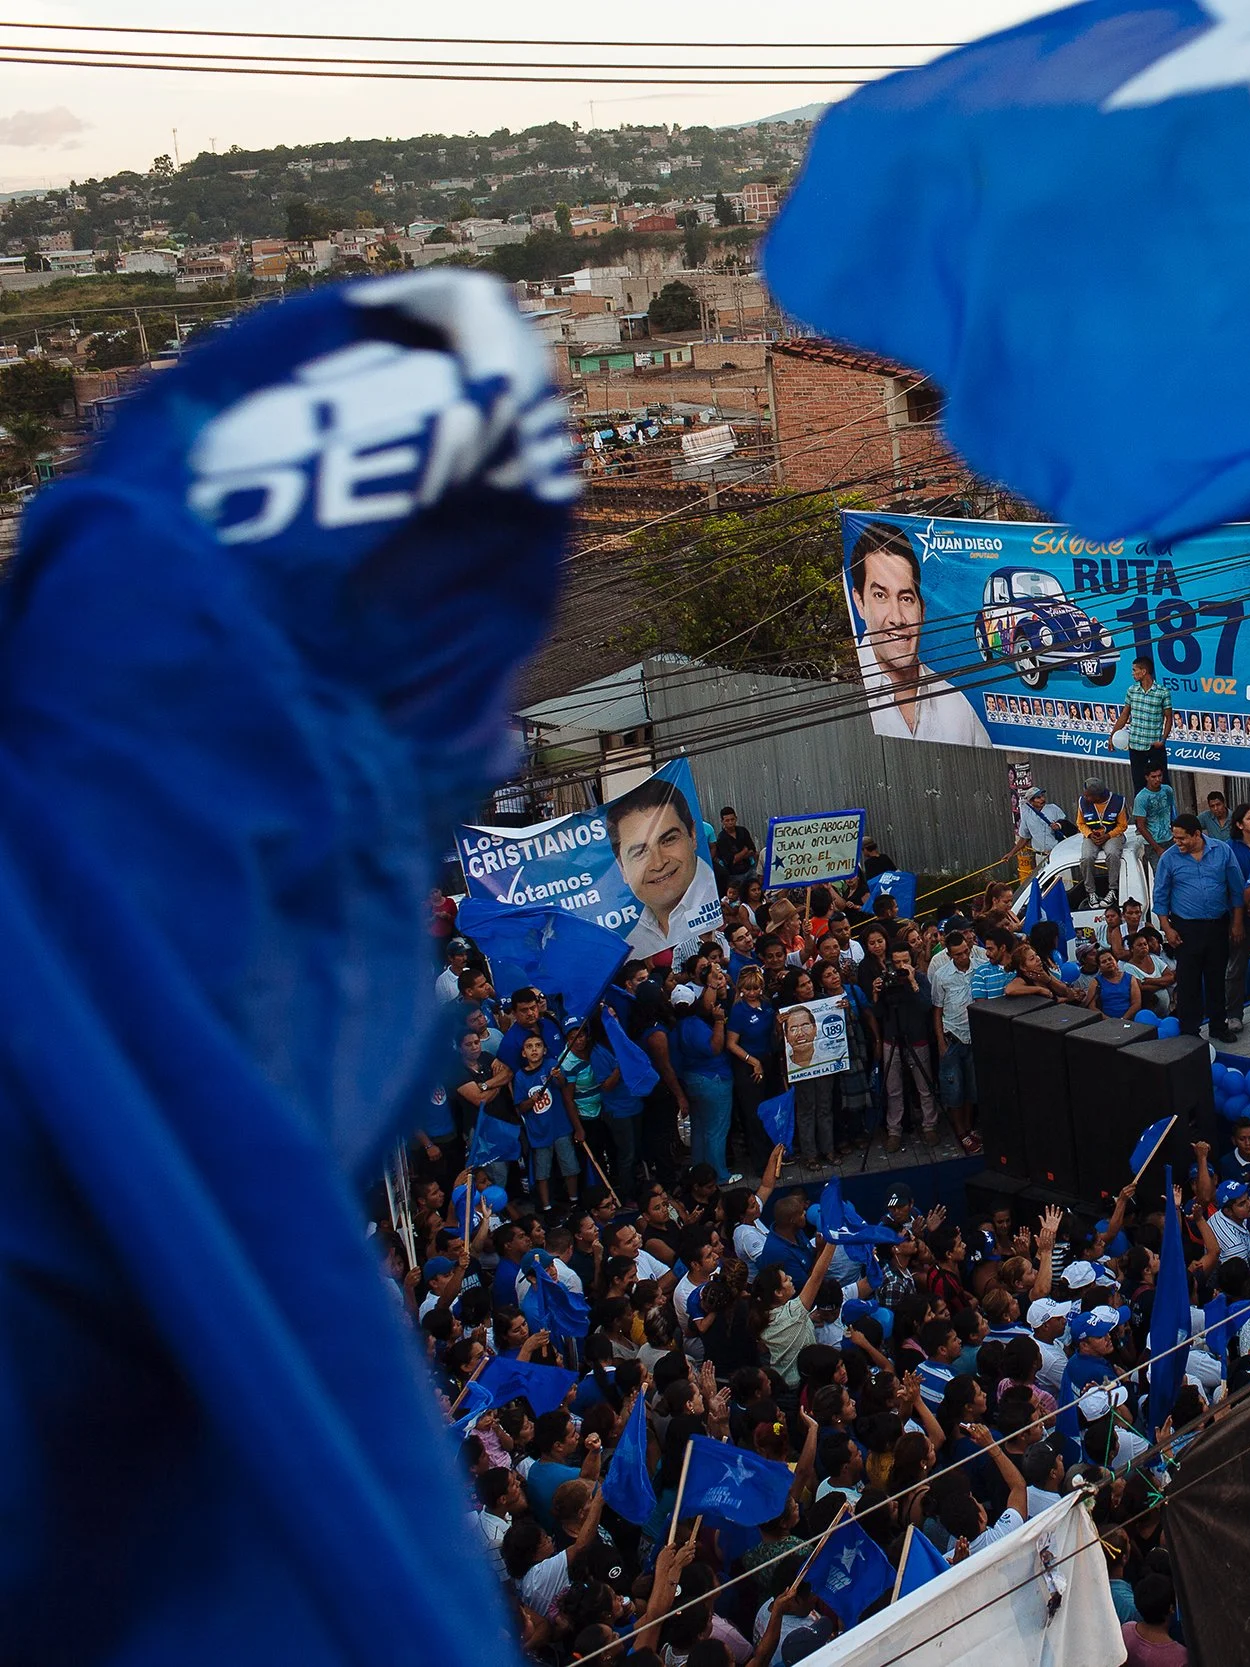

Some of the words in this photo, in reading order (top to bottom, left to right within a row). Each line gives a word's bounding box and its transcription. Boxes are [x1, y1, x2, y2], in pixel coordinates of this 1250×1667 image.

[930, 536, 962, 550] JUAN
[965, 537, 1003, 551] DIEGO
[1072, 558, 1182, 597] RUTA
[1116, 597, 1245, 680] 187
[1180, 678, 1199, 693] TU
[1200, 677, 1237, 695] VOZ
[1174, 745, 1221, 762] azules
[468, 819, 607, 879] CRISTIANOS
[776, 840, 805, 851] JUAN
[811, 831, 859, 847] ORLANDO
[788, 853, 812, 866] POR
[817, 850, 832, 861] EL
[784, 865, 818, 880] BONO
[560, 889, 601, 911] una
[698, 899, 720, 915] JUA
[825, 1024, 841, 1036] 189
[791, 1071, 812, 1080] MARCA
